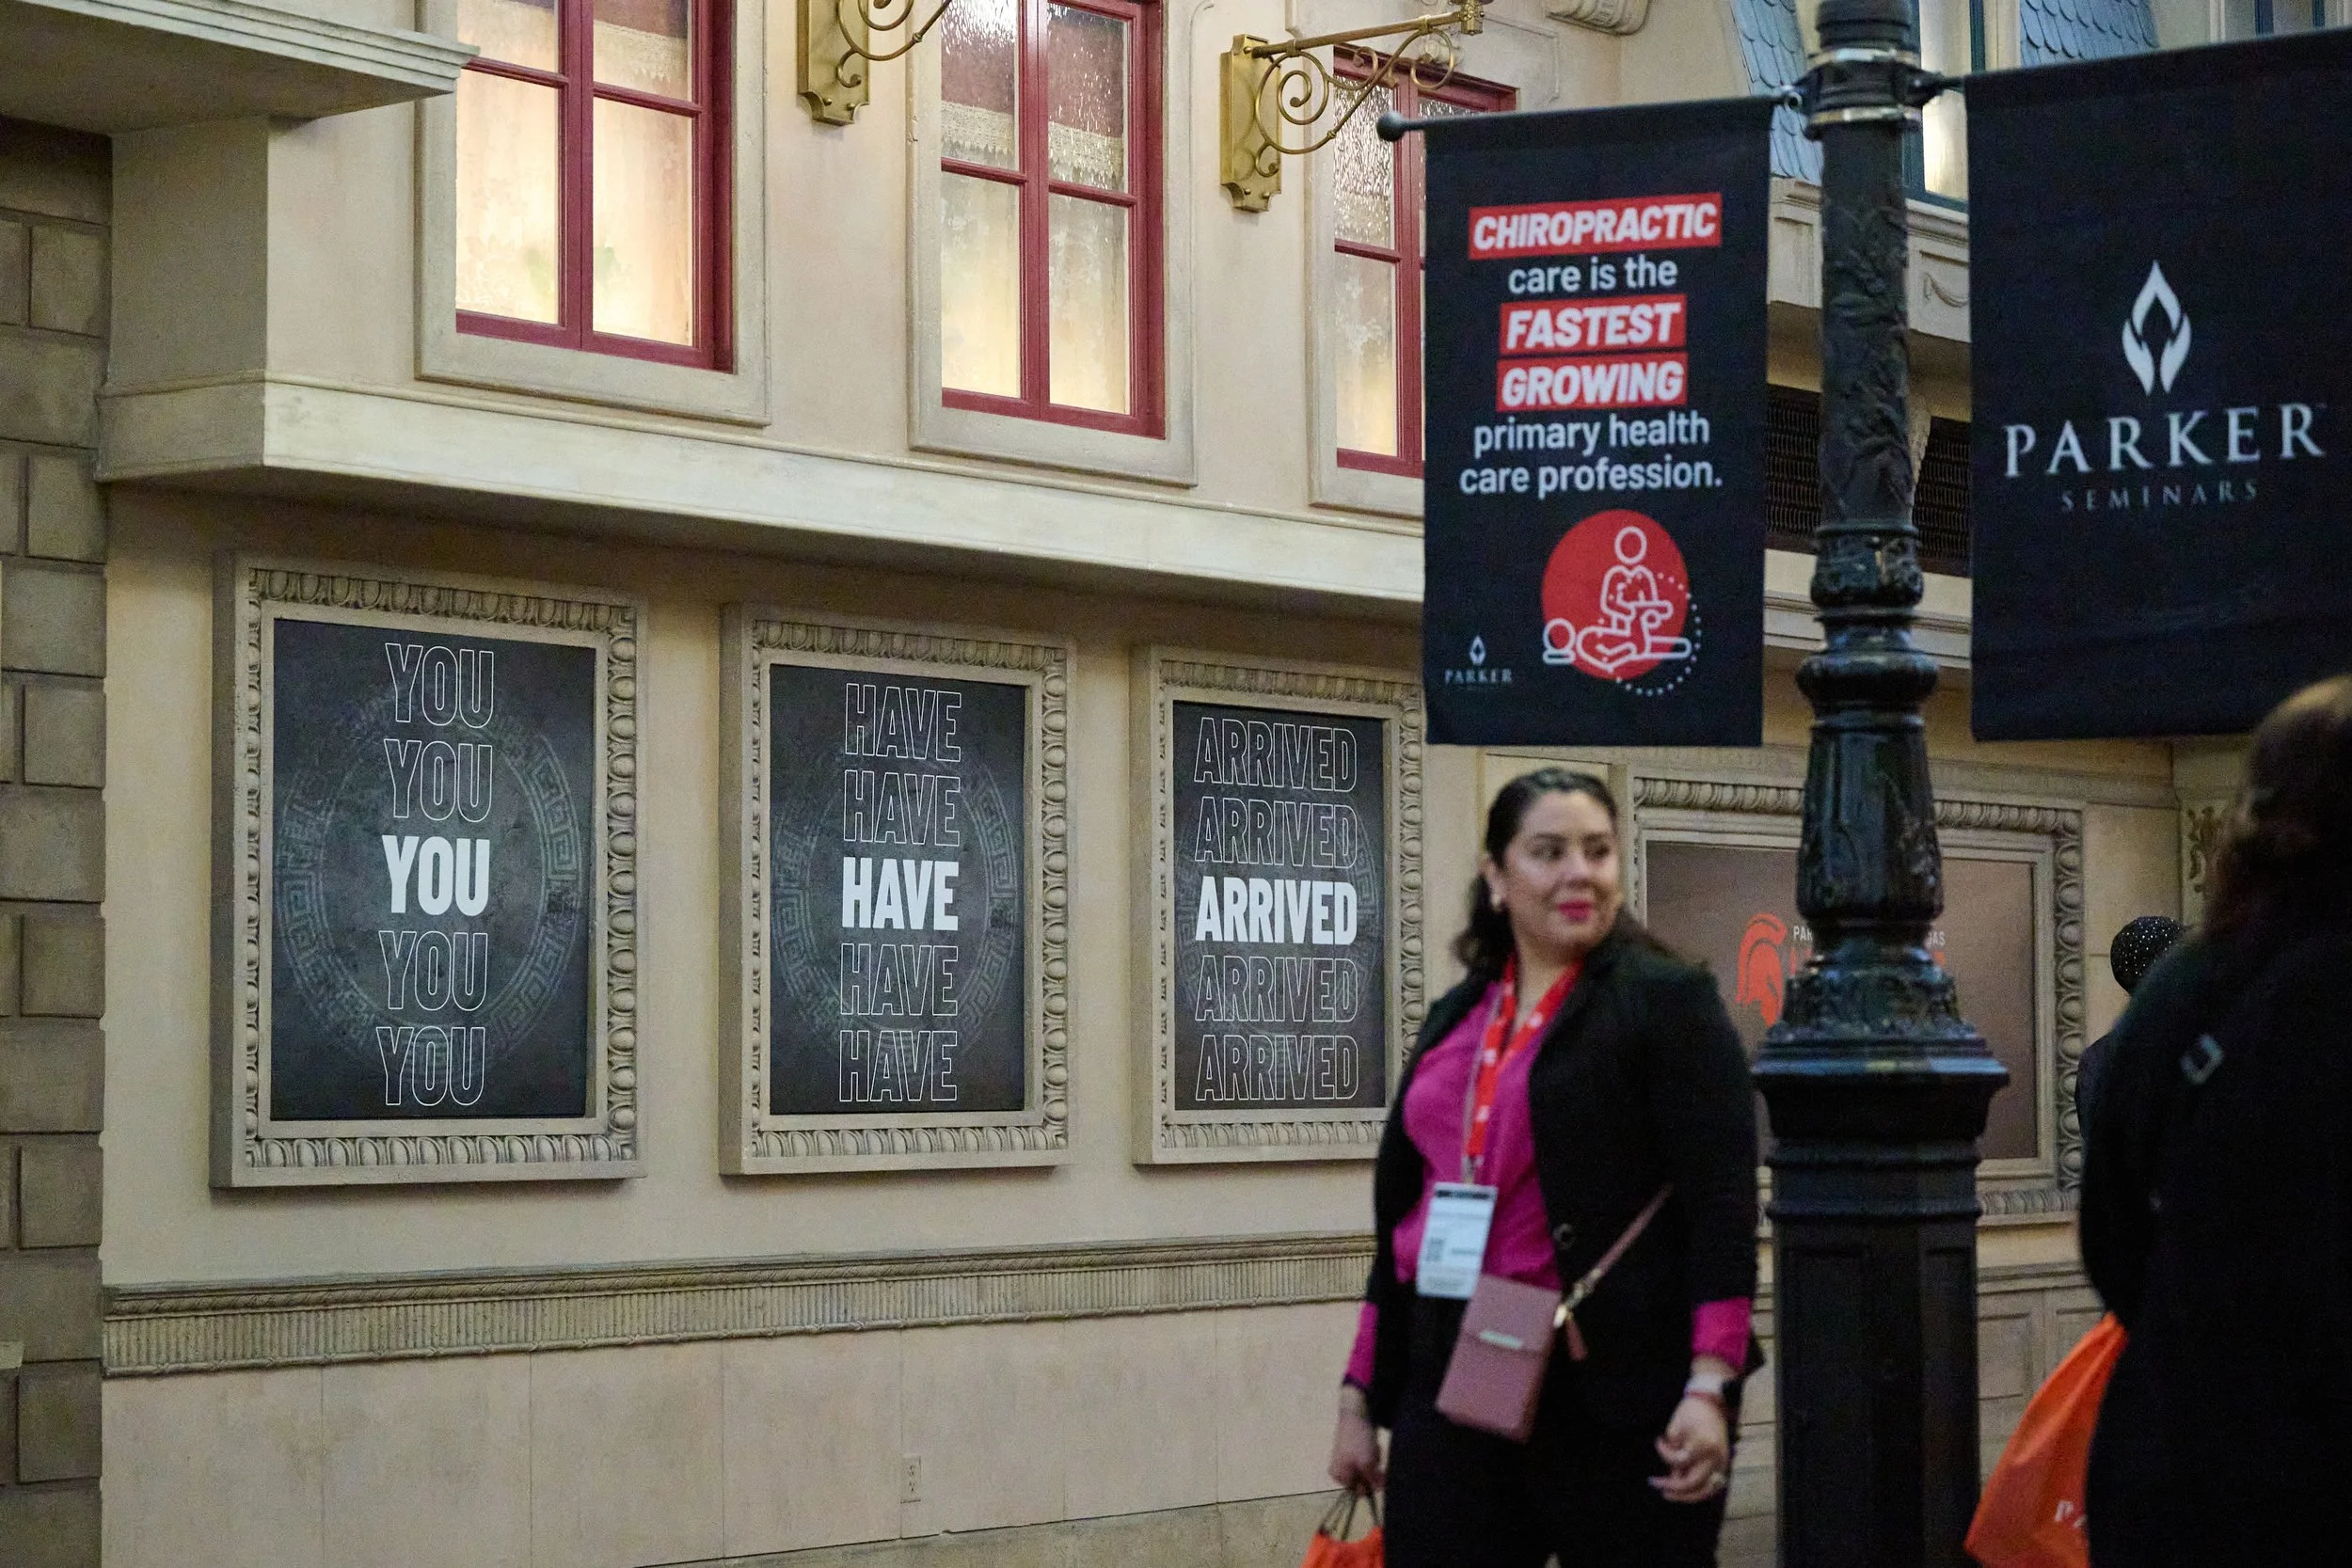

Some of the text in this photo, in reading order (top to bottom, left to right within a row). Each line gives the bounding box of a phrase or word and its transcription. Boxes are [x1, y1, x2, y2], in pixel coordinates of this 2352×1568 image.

[1472, 201, 1718, 251] CHIROPRACTIC
[1507, 253, 1678, 294] care is the
[1505, 301, 1682, 351] FASTEST
[1501, 359, 1685, 407] GROWING
[1473, 409, 1710, 460] primary health
[2003, 402, 2326, 478] PARKER
[1458, 452, 1724, 500] care profession.
[2060, 479, 2259, 513] SEMINARS
[384, 642, 494, 729] YOU
[1443, 669, 1512, 685] PARKER
[845, 682, 962, 763] HAVE
[1193, 716, 1359, 793] ARRIVED
[382, 738, 493, 823] YOU
[843, 768, 961, 847] HAVE
[1194, 796, 1359, 869] ARRIVED
[381, 834, 491, 917] YOU
[841, 856, 960, 931] HAVE
[1195, 875, 1359, 946] ARRIVED
[378, 930, 488, 1012] YOU
[839, 942, 959, 1017] HAVE
[1194, 955, 1359, 1023] ARRIVED
[375, 1025, 485, 1107] YOU
[837, 1029, 958, 1102] HAVE
[1194, 1034, 1359, 1101] ARRIVED
